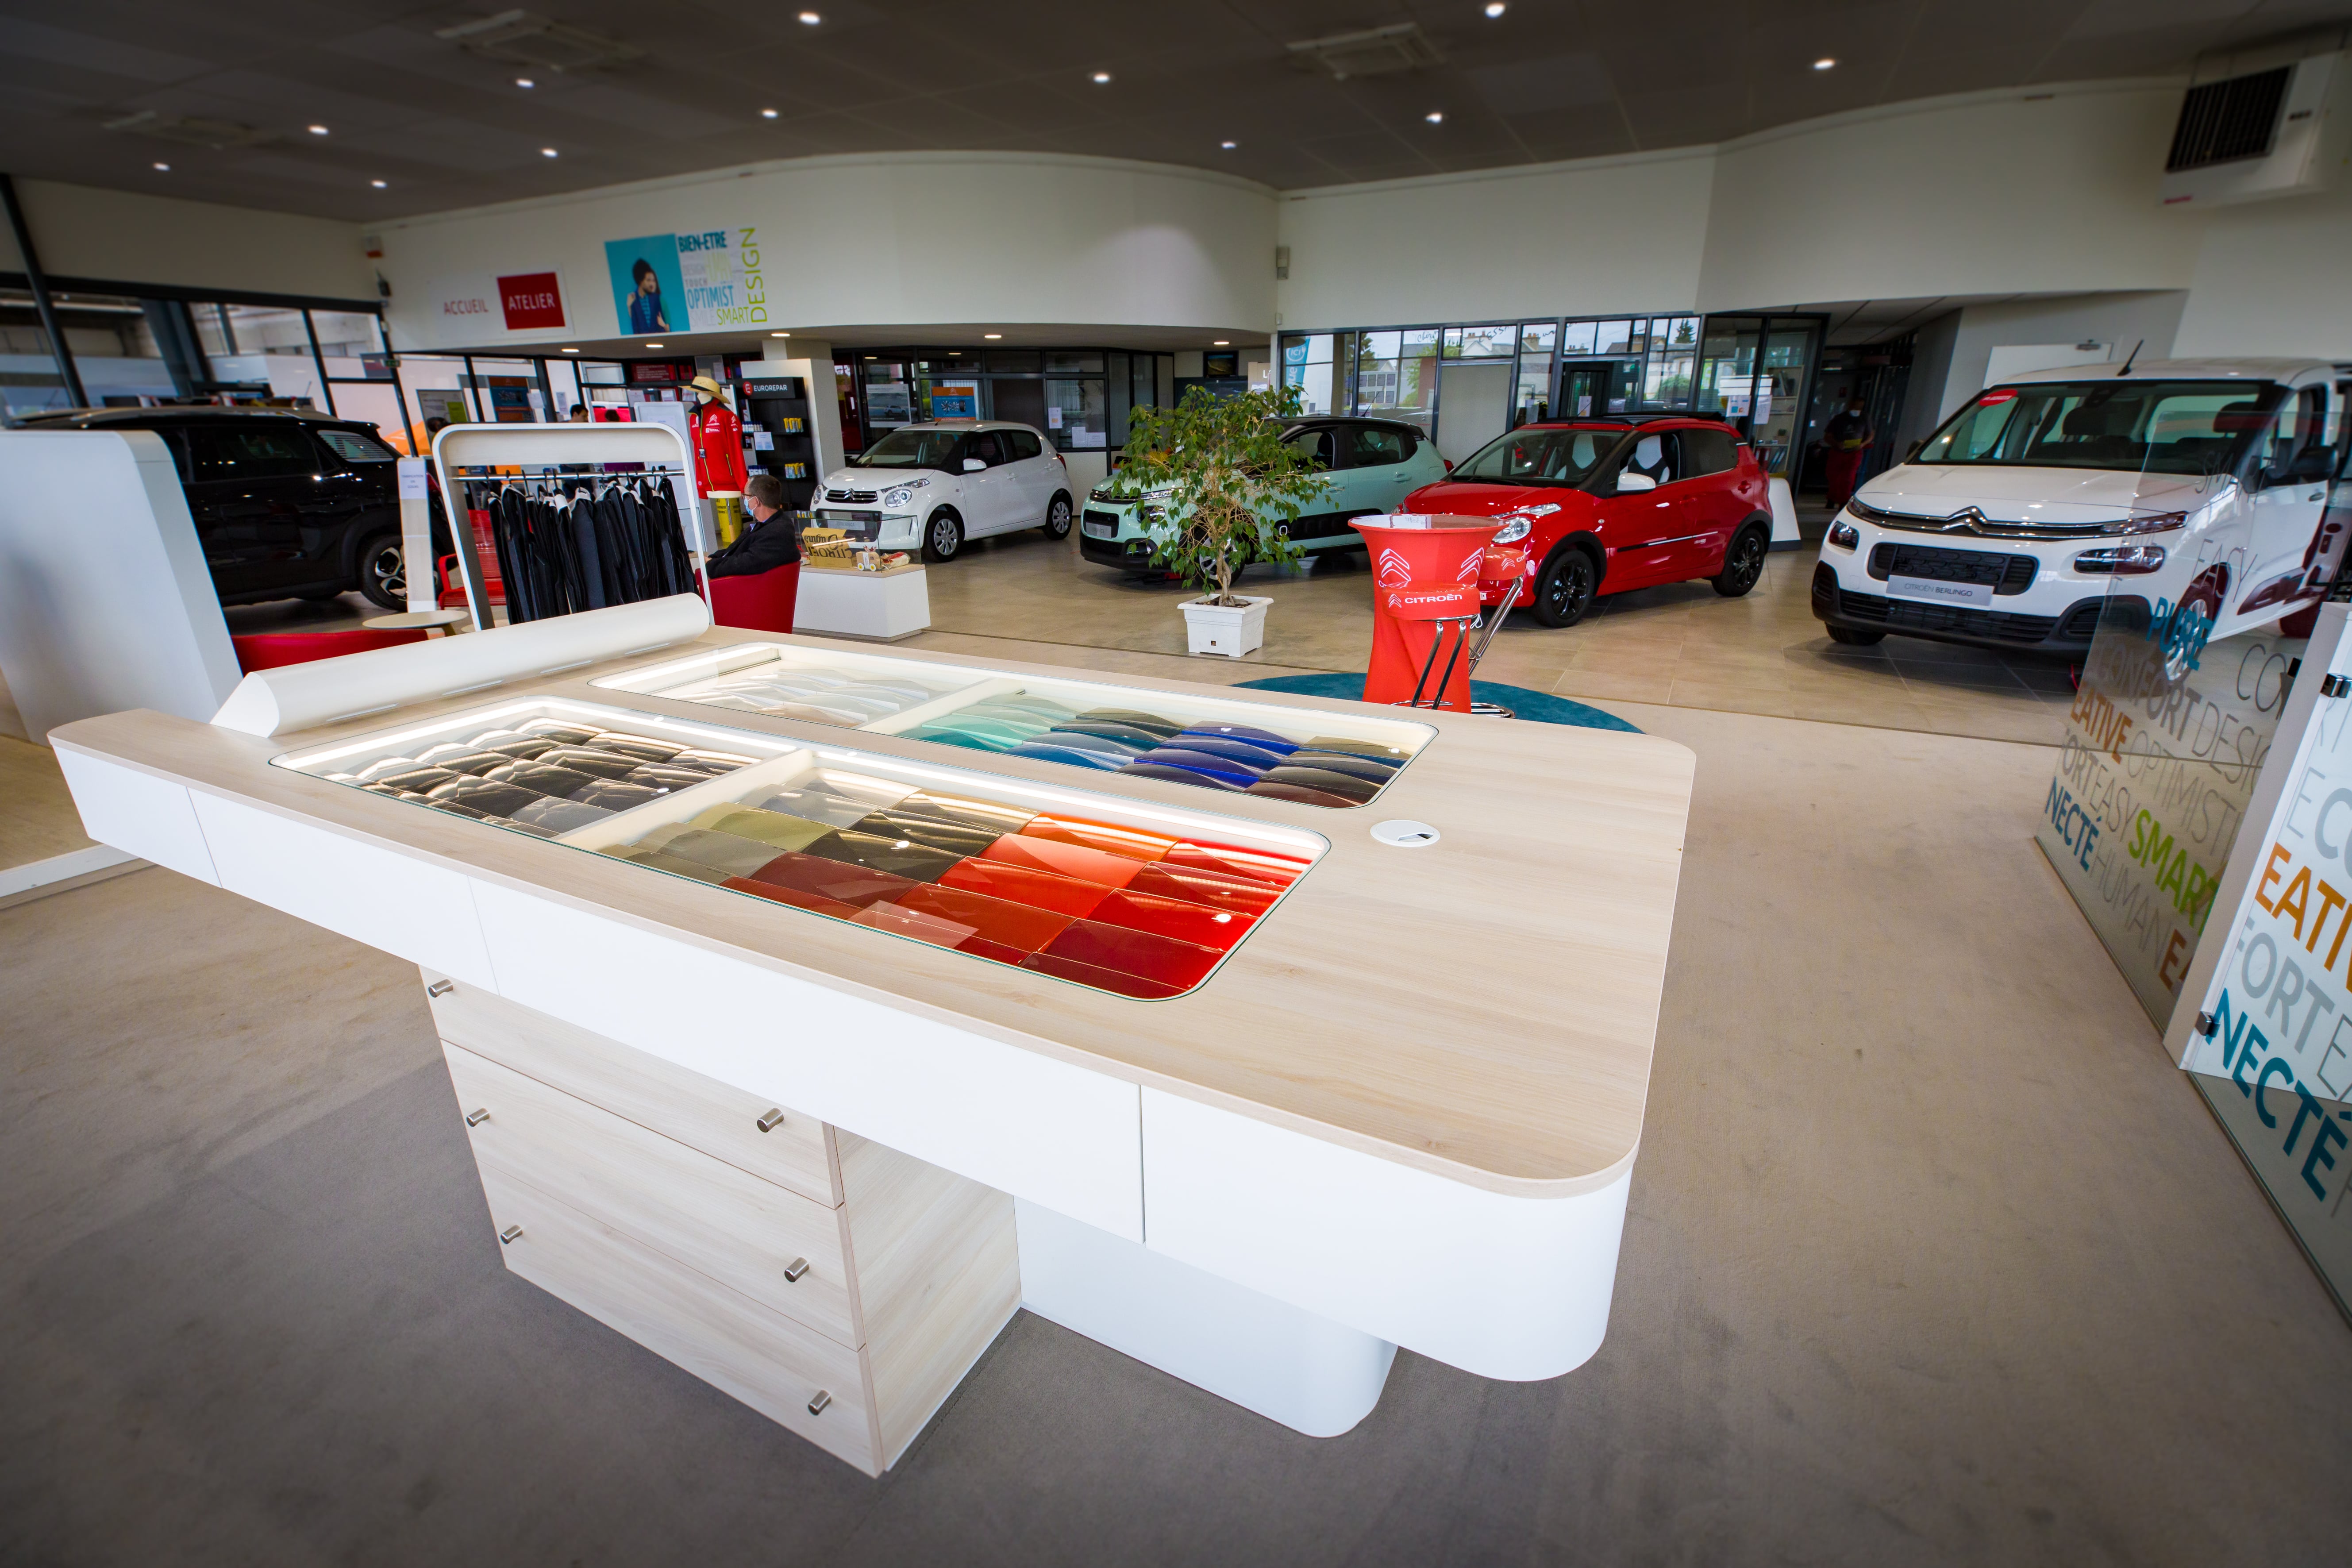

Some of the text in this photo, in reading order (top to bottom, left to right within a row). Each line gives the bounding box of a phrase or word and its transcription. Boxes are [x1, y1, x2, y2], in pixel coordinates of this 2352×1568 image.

[677, 231, 728, 253] BIEN-ETRE
[687, 285, 734, 309] OPTIMIST
[739, 227, 768, 323] DESIGN
[444, 298, 489, 315] ACCUEIL
[508, 292, 556, 311] ATELIER
[716, 306, 750, 325] SMART
[1904, 583, 1973, 597] CITROËN BERLINGO
[2191, 538, 2258, 603] EASY
[2146, 596, 2213, 671] PURE
[2044, 776, 2102, 872] NECTÉ
[2090, 764, 2140, 842] EASY
[2205, 987, 2352, 1202] NECTÉ
